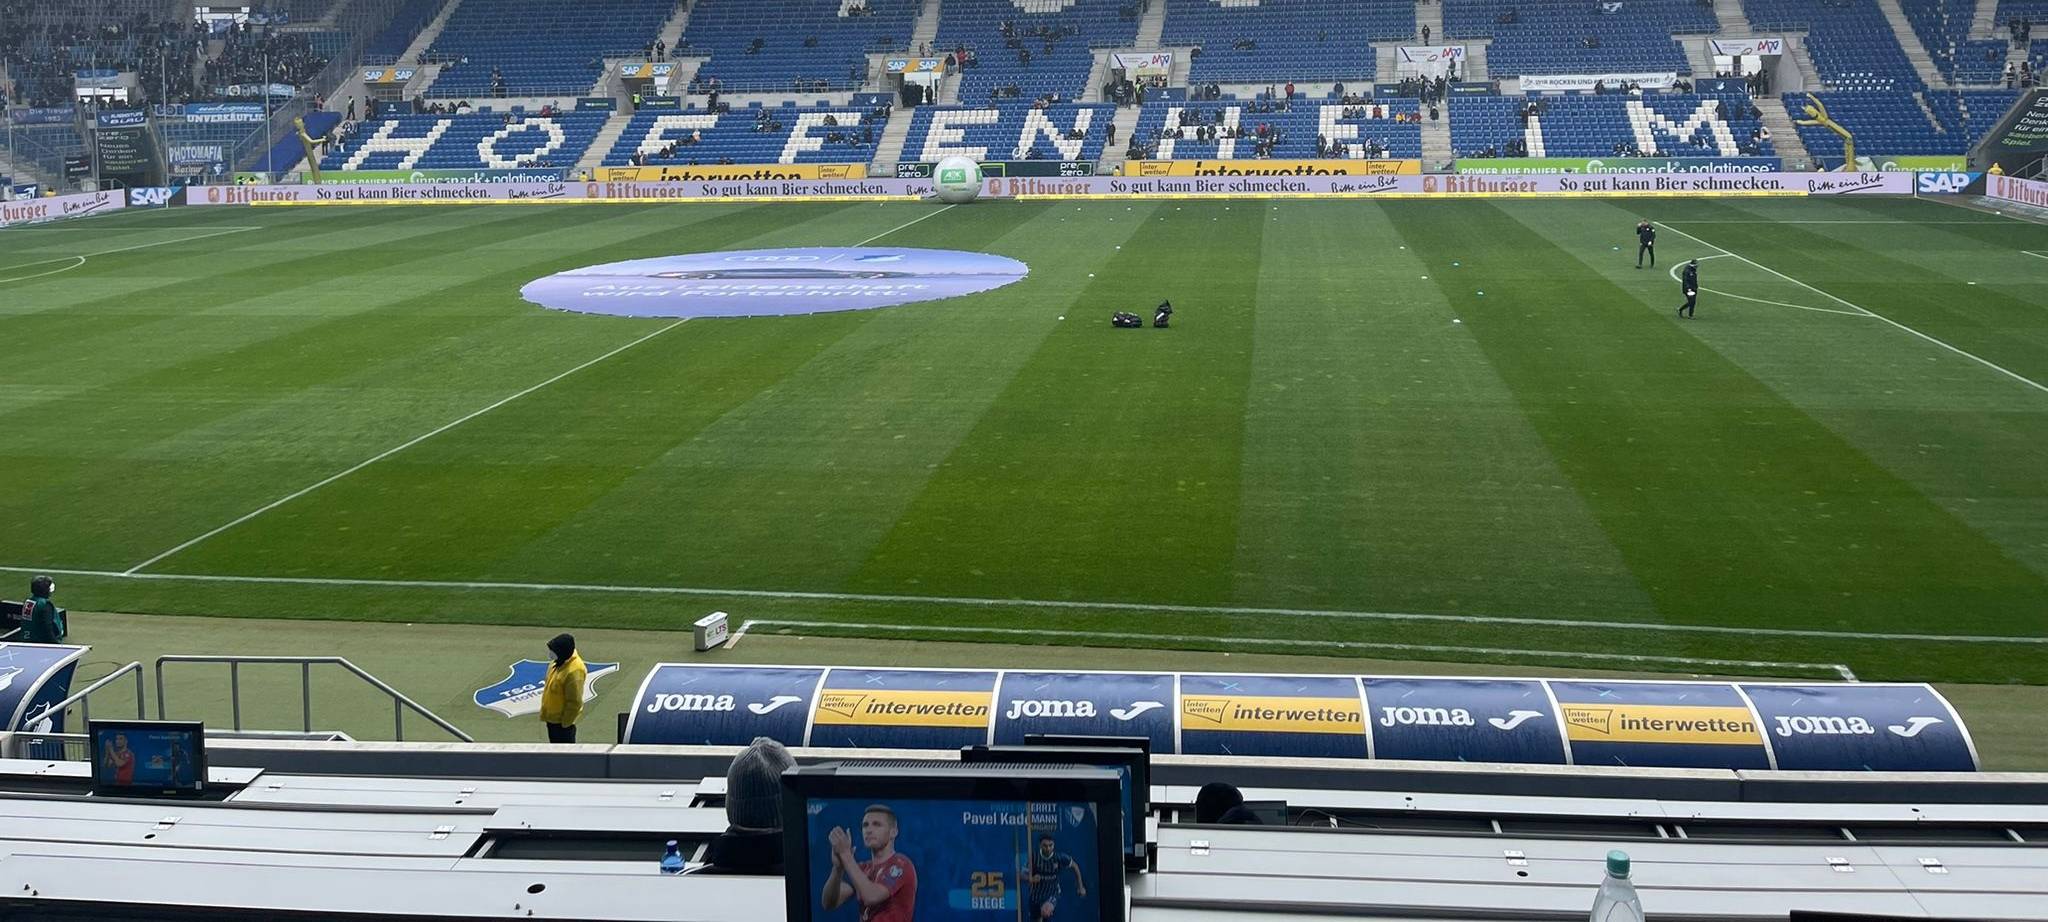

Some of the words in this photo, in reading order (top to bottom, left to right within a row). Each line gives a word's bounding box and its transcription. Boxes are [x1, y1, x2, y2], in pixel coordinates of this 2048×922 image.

[622, 66, 640, 75] SAP
[653, 66, 670, 75] SAP
[887, 61, 906, 71] SAP
[919, 61, 937, 70] SAP
[365, 71, 382, 80] SAP
[394, 71, 412, 80] SAP
[898, 164, 915, 173] pre
[1060, 162, 1078, 171] pre
[1060, 169, 1084, 177] zero
[548, 183, 566, 194] Bit
[606, 182, 683, 199] Bitburger
[702, 183, 718, 196] So
[721, 184, 742, 197] gut
[746, 182, 777, 196] kann
[782, 182, 809, 195] Bier
[812, 181, 888, 195] schmecken.
[906, 184, 929, 196] Bitte
[1008, 178, 1091, 195] Bitburger
[1110, 180, 1127, 193] So
[1131, 180, 1152, 194] gut
[1157, 179, 1191, 192] kann
[1195, 179, 1225, 192] Bier
[1229, 178, 1311, 192] schmecken.
[1331, 182, 1356, 194] Bitte
[1358, 183, 1376, 191] ein
[1377, 175, 1398, 187] Bit
[1445, 175, 1538, 193] Bitburger
[1559, 177, 1578, 191] So
[1583, 179, 1607, 193] gut
[1612, 176, 1650, 190] kann
[1656, 176, 1688, 190] Bier
[1693, 176, 1785, 190] schmecken.
[1808, 179, 1835, 193] Bitte
[1838, 180, 1859, 188] ein
[1861, 172, 1884, 185] Bit
[1918, 172, 1970, 193] SAP
[131, 187, 173, 205] SAP
[226, 186, 300, 203] Bitburger
[316, 187, 331, 199] So
[335, 188, 354, 200] gut
[358, 186, 388, 199] kann
[392, 186, 417, 199] Bier
[420, 186, 491, 199] schmecken.
[63, 201, 81, 214] Bitte
[95, 192, 110, 204] Bit
[583, 289, 671, 297] wird
[680, 289, 908, 297] Fortschritt.
[676, 283, 930, 291] Leidenschaft
[865, 698, 989, 716] interwetten
[1188, 705, 1224, 715] wetten
[1233, 704, 1361, 723] interwetten
[1571, 715, 1607, 725] wetten
[1620, 713, 1755, 733] interwetten
[962, 811, 997, 825] Pavel
[970, 871, 1005, 896] 25
[971, 897, 1006, 910] SIEGE
